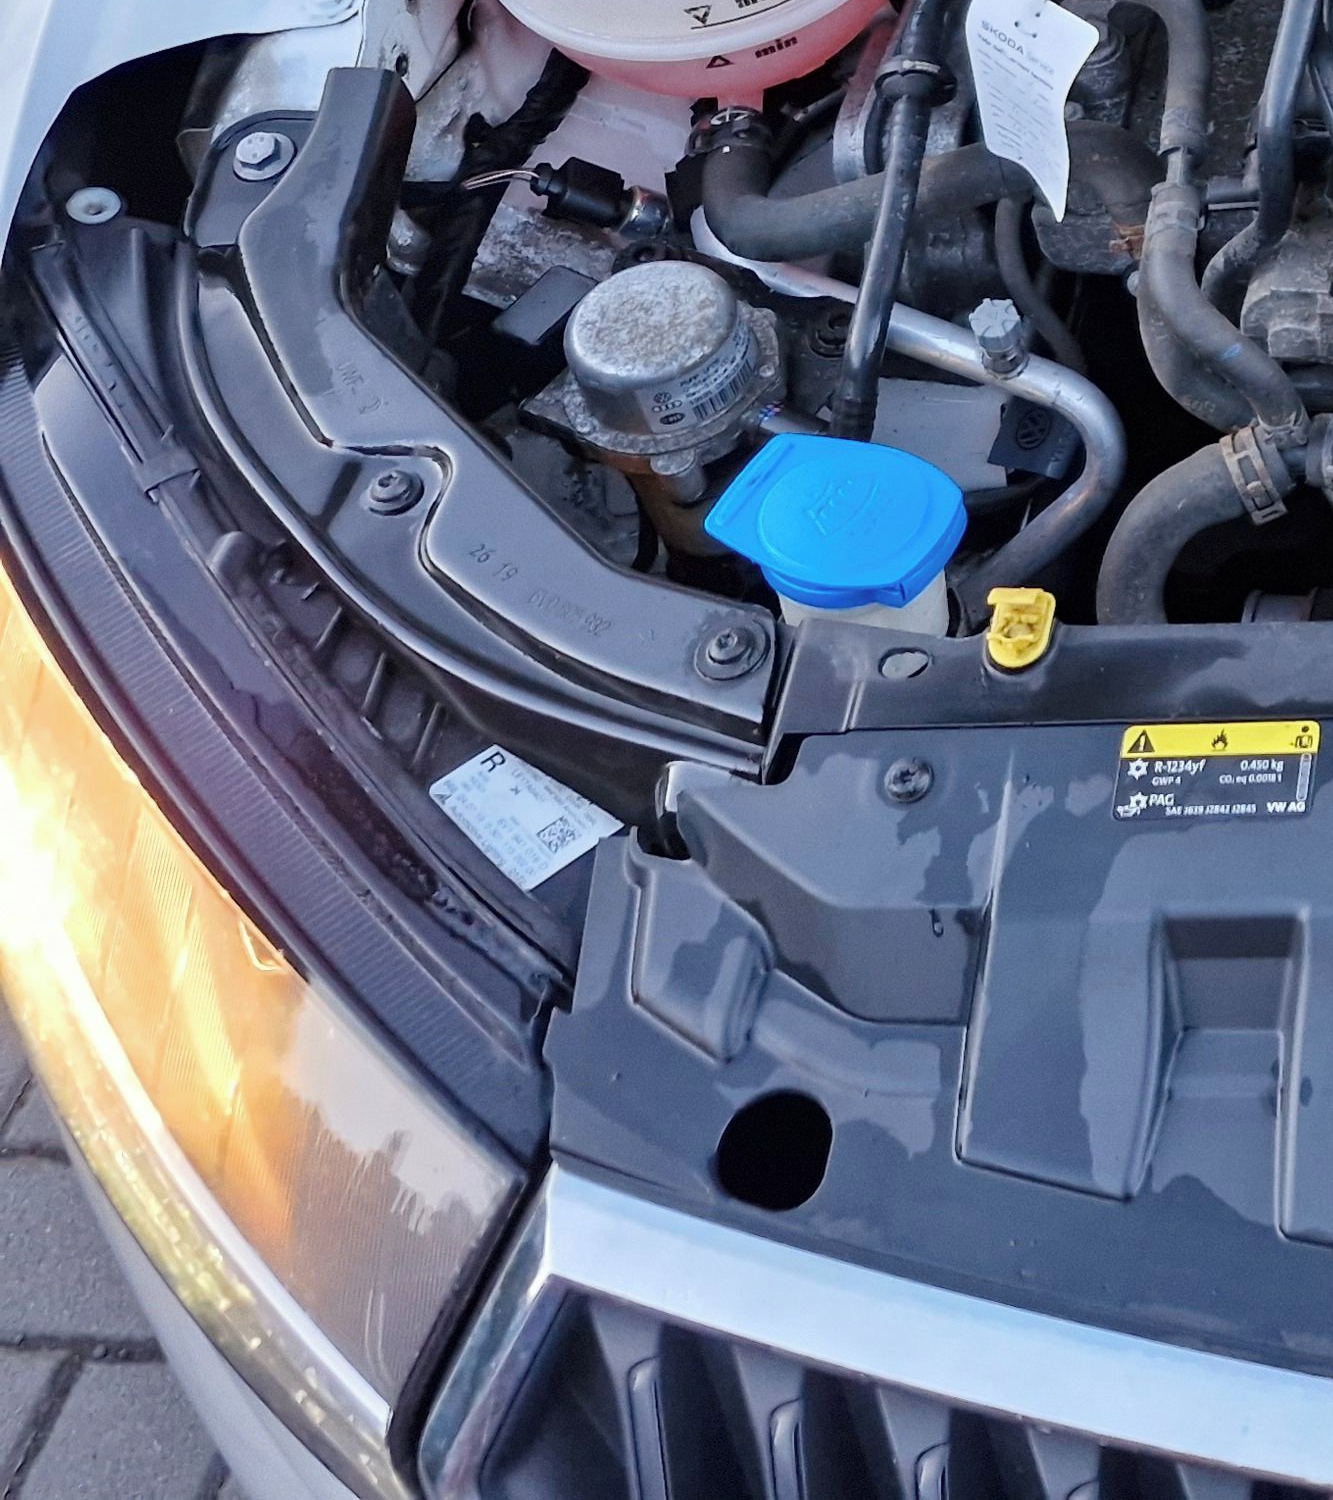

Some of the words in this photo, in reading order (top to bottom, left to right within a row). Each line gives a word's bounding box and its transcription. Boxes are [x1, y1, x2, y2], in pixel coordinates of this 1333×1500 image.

[755, 37, 798, 59] min
[480, 751, 507, 774] R
[1153, 759, 1206, 776] R-1234yf
[1240, 759, 1269, 772] 0.450
[1270, 759, 1284, 773] kg
[1151, 776, 1173, 787] GWP
[1235, 775, 1247, 786] eq
[1149, 793, 1175, 807] PAG
[1266, 801, 1286, 814] VW
[1285, 801, 1306, 813] AG
